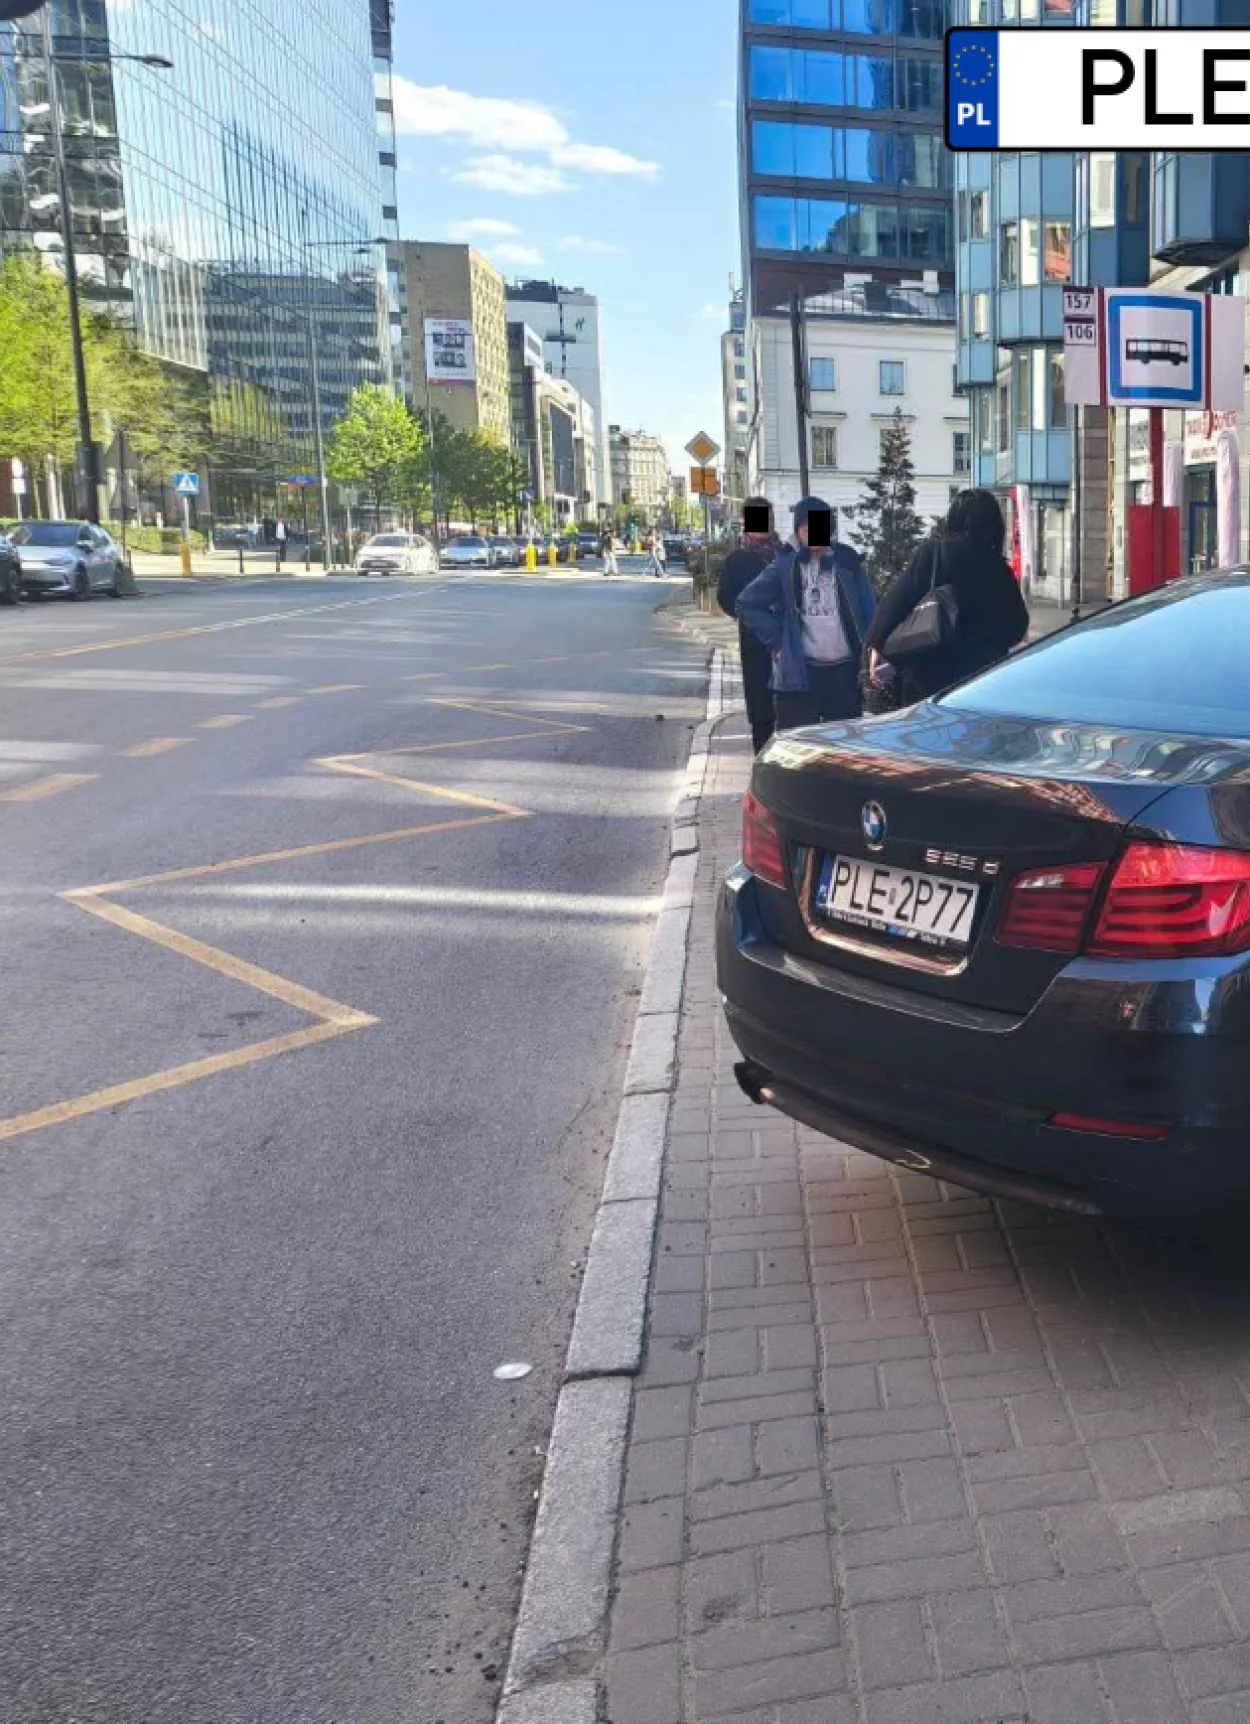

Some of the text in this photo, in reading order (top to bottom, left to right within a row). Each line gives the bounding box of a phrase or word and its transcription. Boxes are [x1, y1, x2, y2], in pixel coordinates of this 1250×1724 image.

[1066, 296, 1091, 309] 157
[1067, 325, 1093, 340] 106
[831, 860, 890, 914] PLE
[895, 875, 974, 933] 2P77
